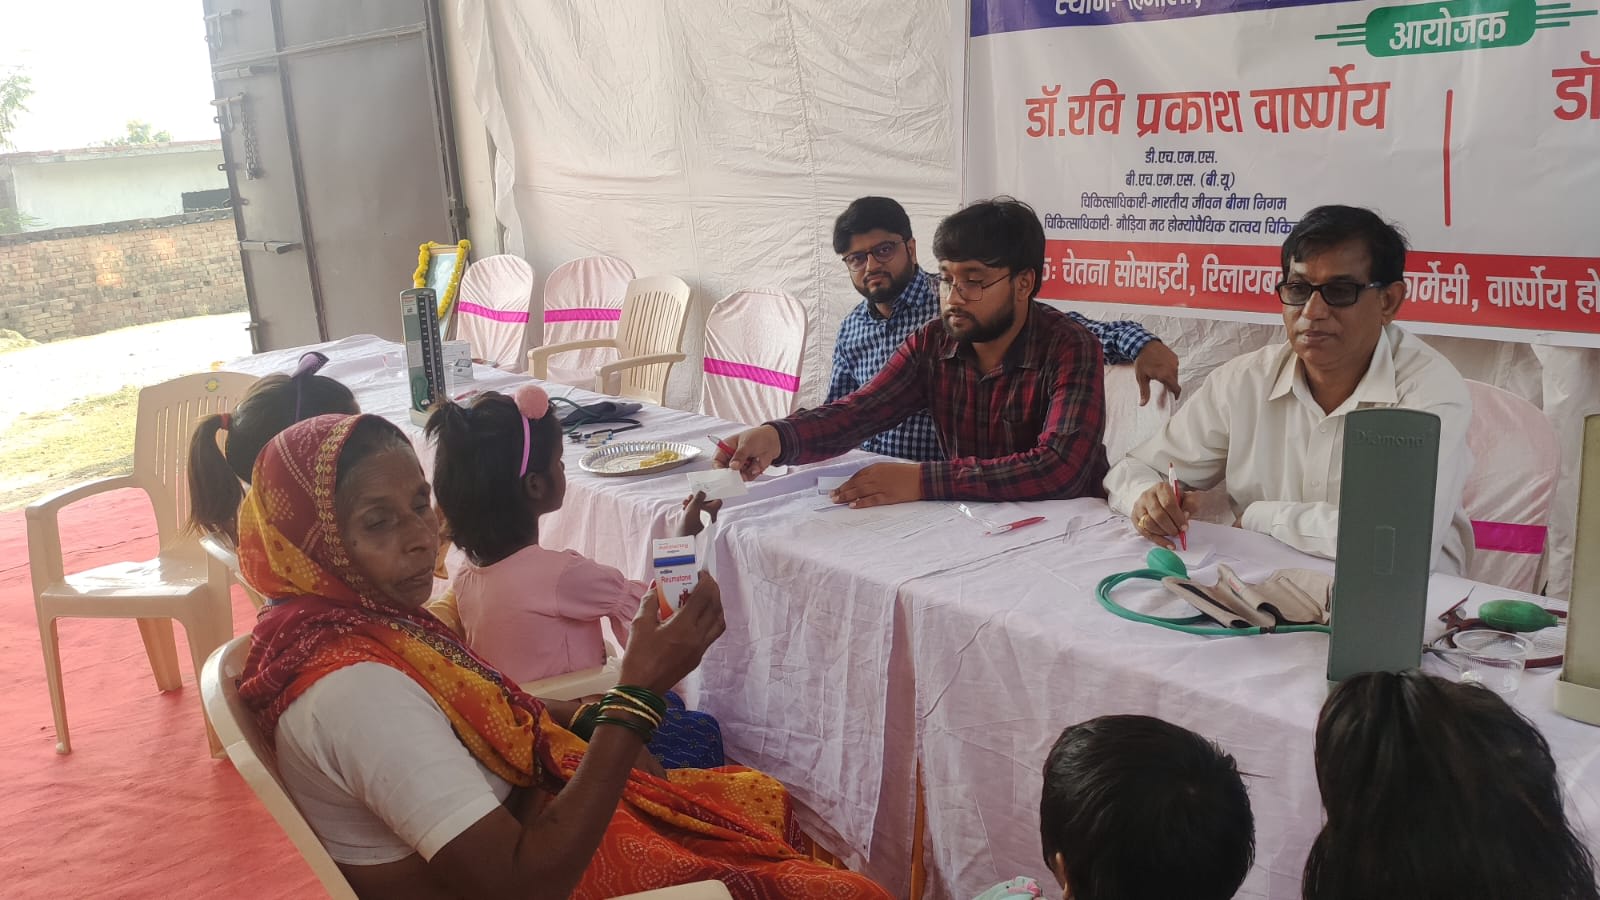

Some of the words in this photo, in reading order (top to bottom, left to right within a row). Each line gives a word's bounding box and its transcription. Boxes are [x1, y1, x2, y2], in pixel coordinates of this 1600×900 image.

[1389, 8, 1509, 50] आयोजक
[1026, 78, 1126, 137] डॉ.रवि
[1136, 91, 1244, 138] प्रकाश
[1250, 63, 1391, 134] वार्ष्णेय
[1145, 147, 1218, 164] डी.एच.एम.एस.
[1125, 169, 1196, 187] बी.एच.एम.एस.
[1191, 195, 1222, 210] जीवन
[1225, 193, 1250, 211] बीमा
[1252, 193, 1287, 212] निगम
[1167, 215, 1226, 233] होम्योपैथिक
[1062, 248, 1110, 286] चेतना
[1114, 251, 1195, 297] सोसाइटी,
[1486, 266, 1568, 311] वार्ष्णेय
